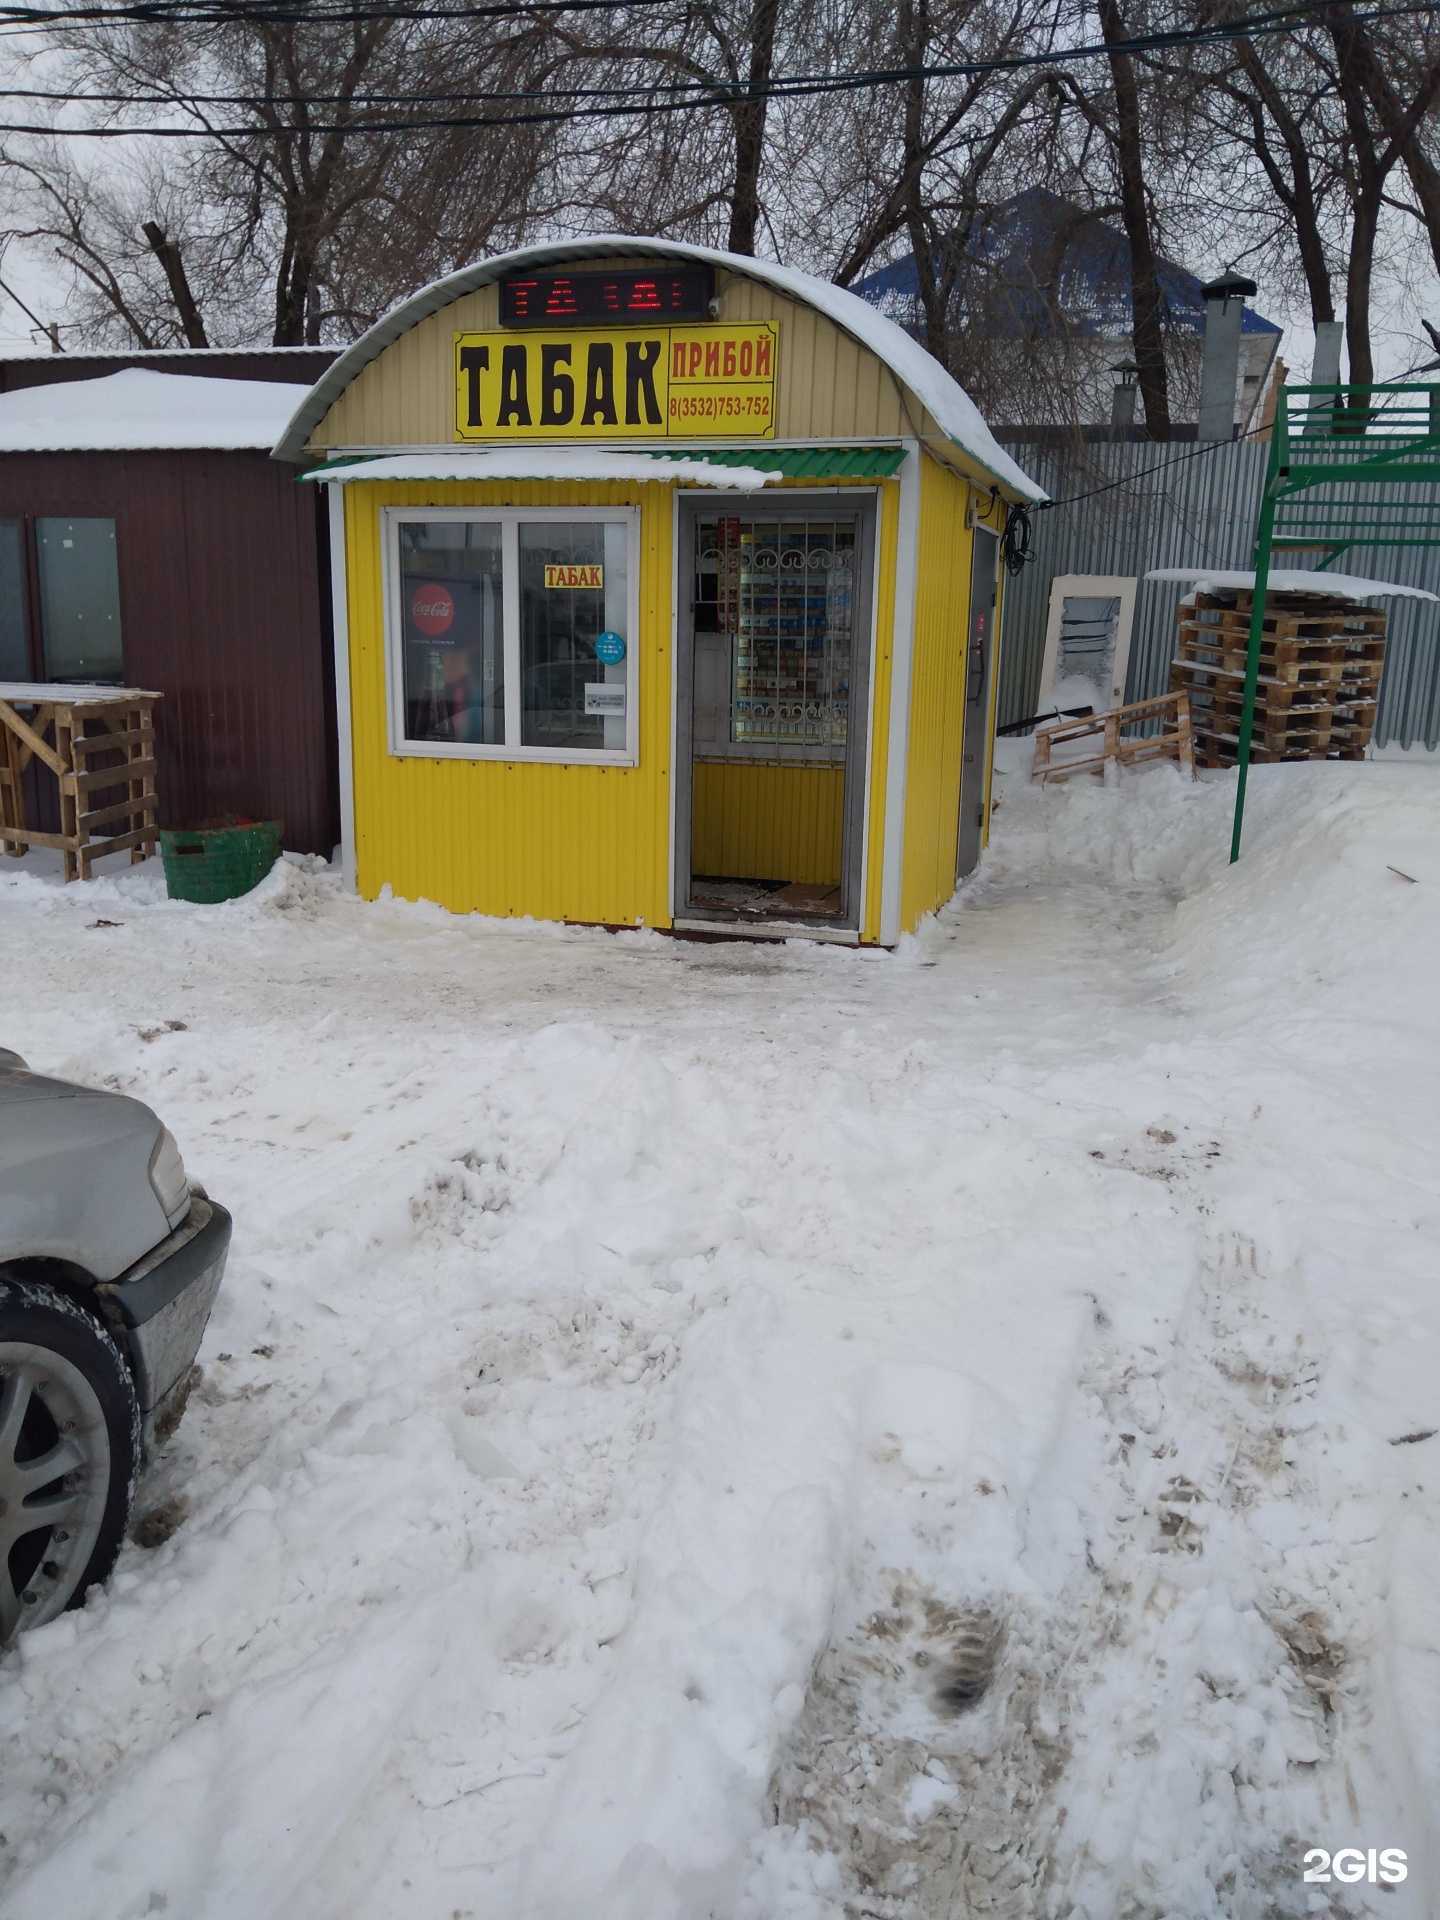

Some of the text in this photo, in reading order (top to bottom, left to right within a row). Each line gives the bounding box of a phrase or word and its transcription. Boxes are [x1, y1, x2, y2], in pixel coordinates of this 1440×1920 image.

[672, 334, 771, 378] ПРИБОЙ
[460, 340, 663, 427] ТАБАК
[669, 395, 770, 422] 8(3532)753-752
[546, 566, 602, 587] ТАБАК
